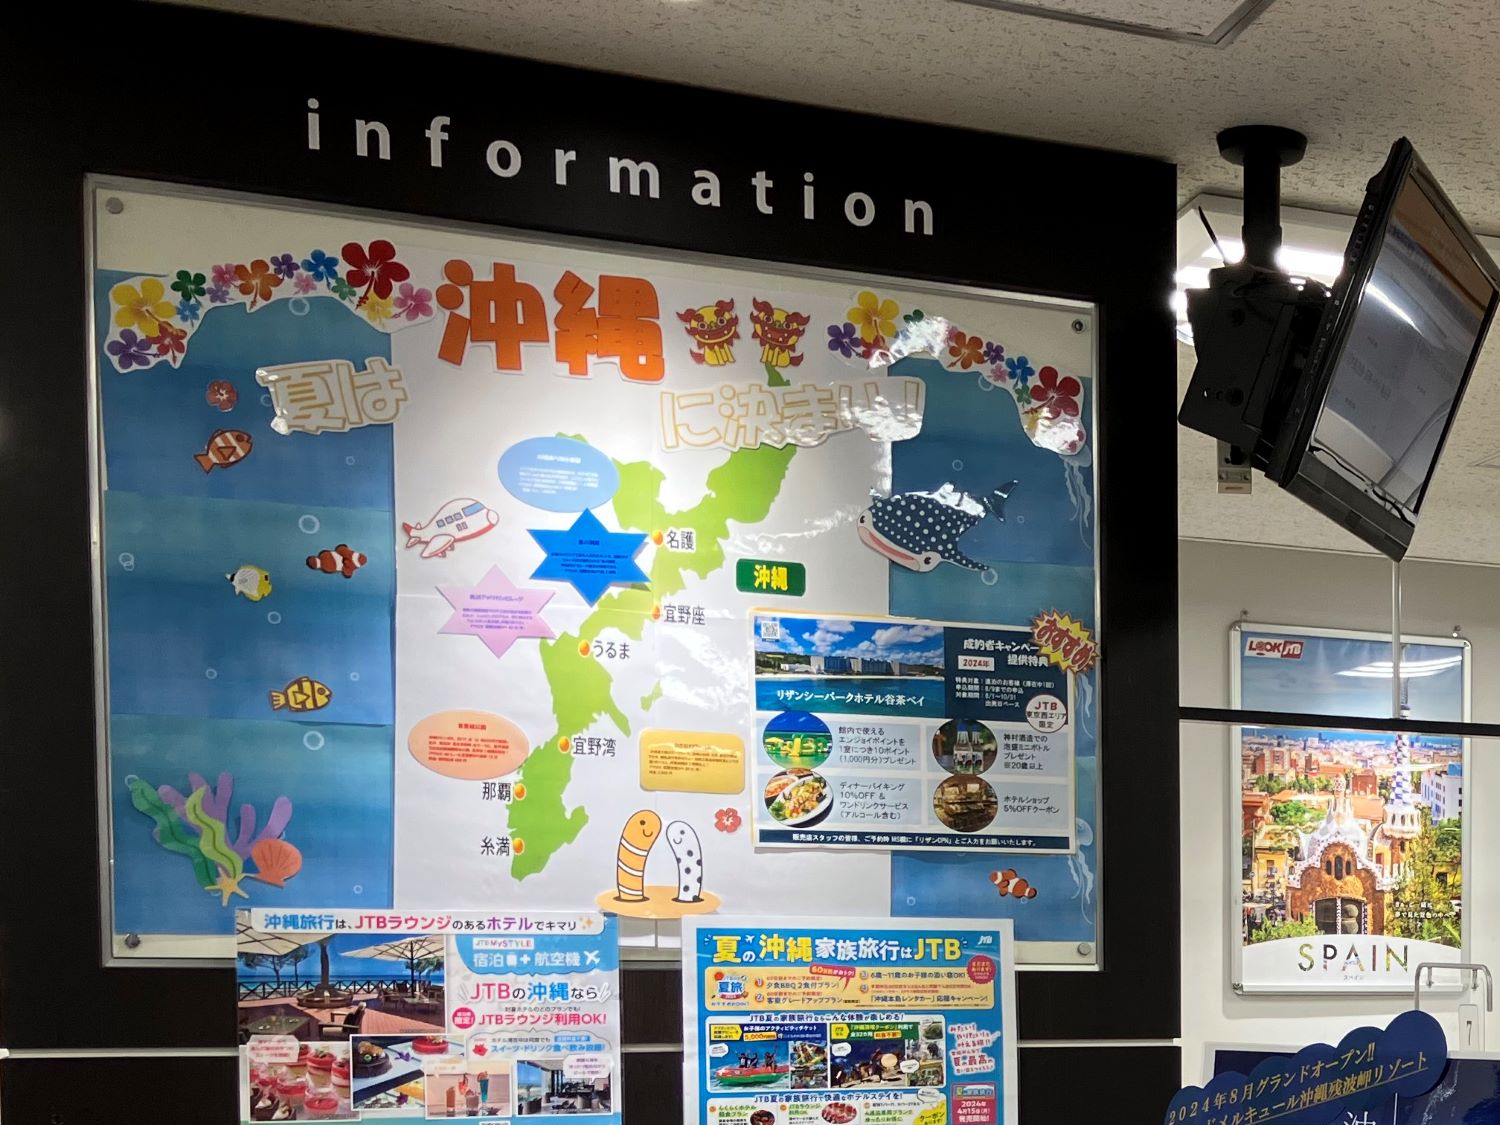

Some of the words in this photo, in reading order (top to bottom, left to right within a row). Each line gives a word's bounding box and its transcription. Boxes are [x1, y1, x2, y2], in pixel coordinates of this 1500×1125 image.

[306, 97, 935, 236] information
[435, 258, 665, 382] 沖縄
[666, 530, 694, 551] 名護
[753, 564, 789, 591] 沖縄
[663, 604, 706, 625] 宜野座
[593, 640, 630, 660] うるま
[1035, 701, 1058, 711] JTB
[572, 736, 617, 758] 宜野湾
[482, 781, 511, 802] 那覇
[480, 836, 511, 857] 糸満
[1297, 943, 1409, 974] SPAIN
[470, 981, 598, 1001] JTBの沖縄なら
[1466, 1020, 1472, 1046] 7
